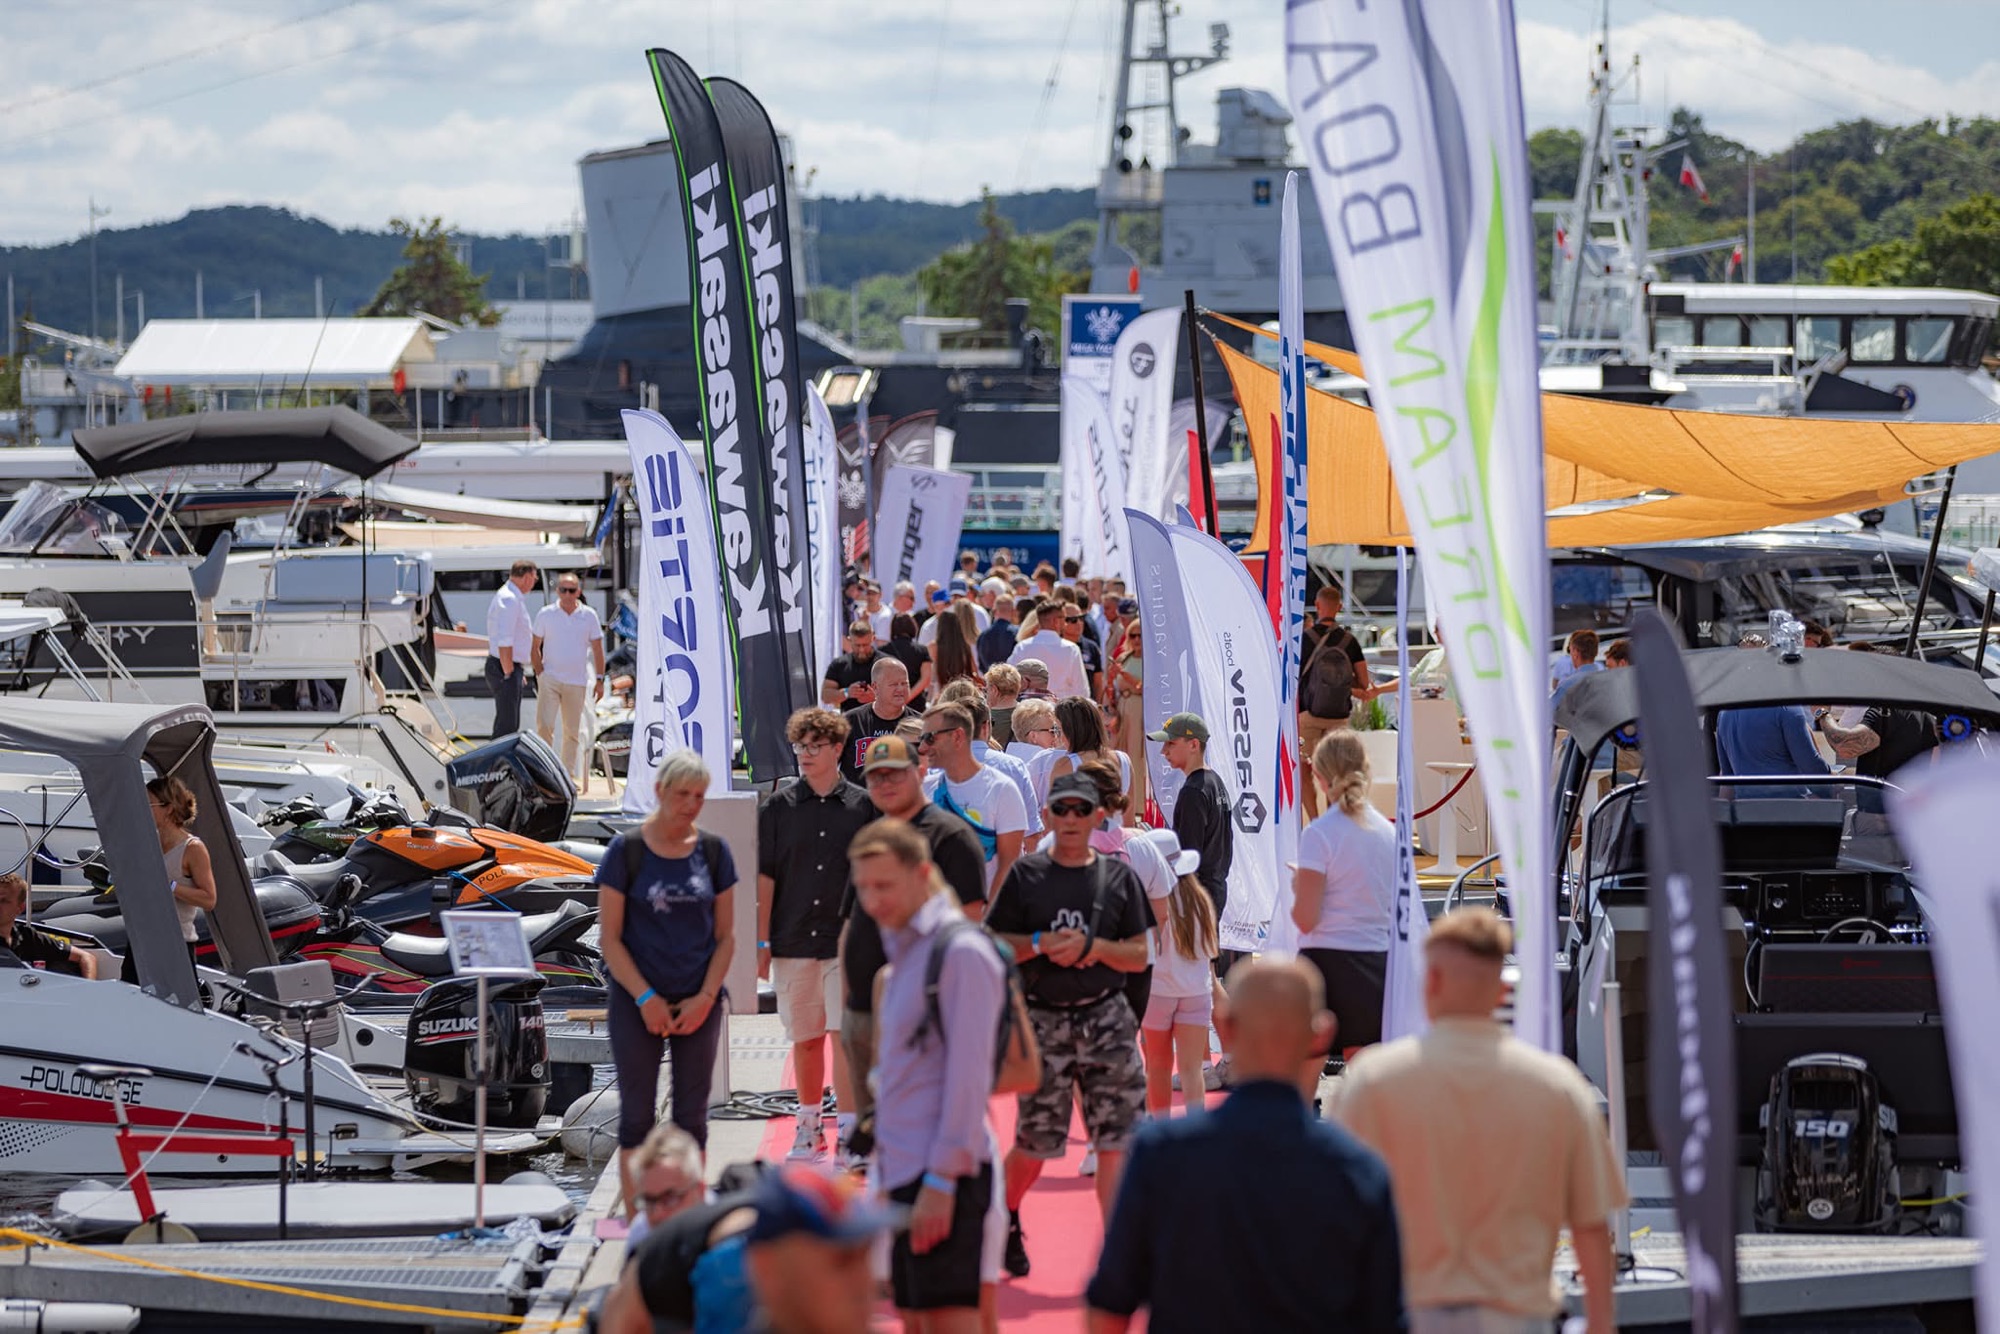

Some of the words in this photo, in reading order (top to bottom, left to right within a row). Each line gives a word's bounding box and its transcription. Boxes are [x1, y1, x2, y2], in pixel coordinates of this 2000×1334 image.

[455, 770, 509, 788] MERCURY
[418, 1016, 480, 1035] SUZUK
[519, 1015, 544, 1030] 140
[1795, 1119, 1849, 1138] 150
